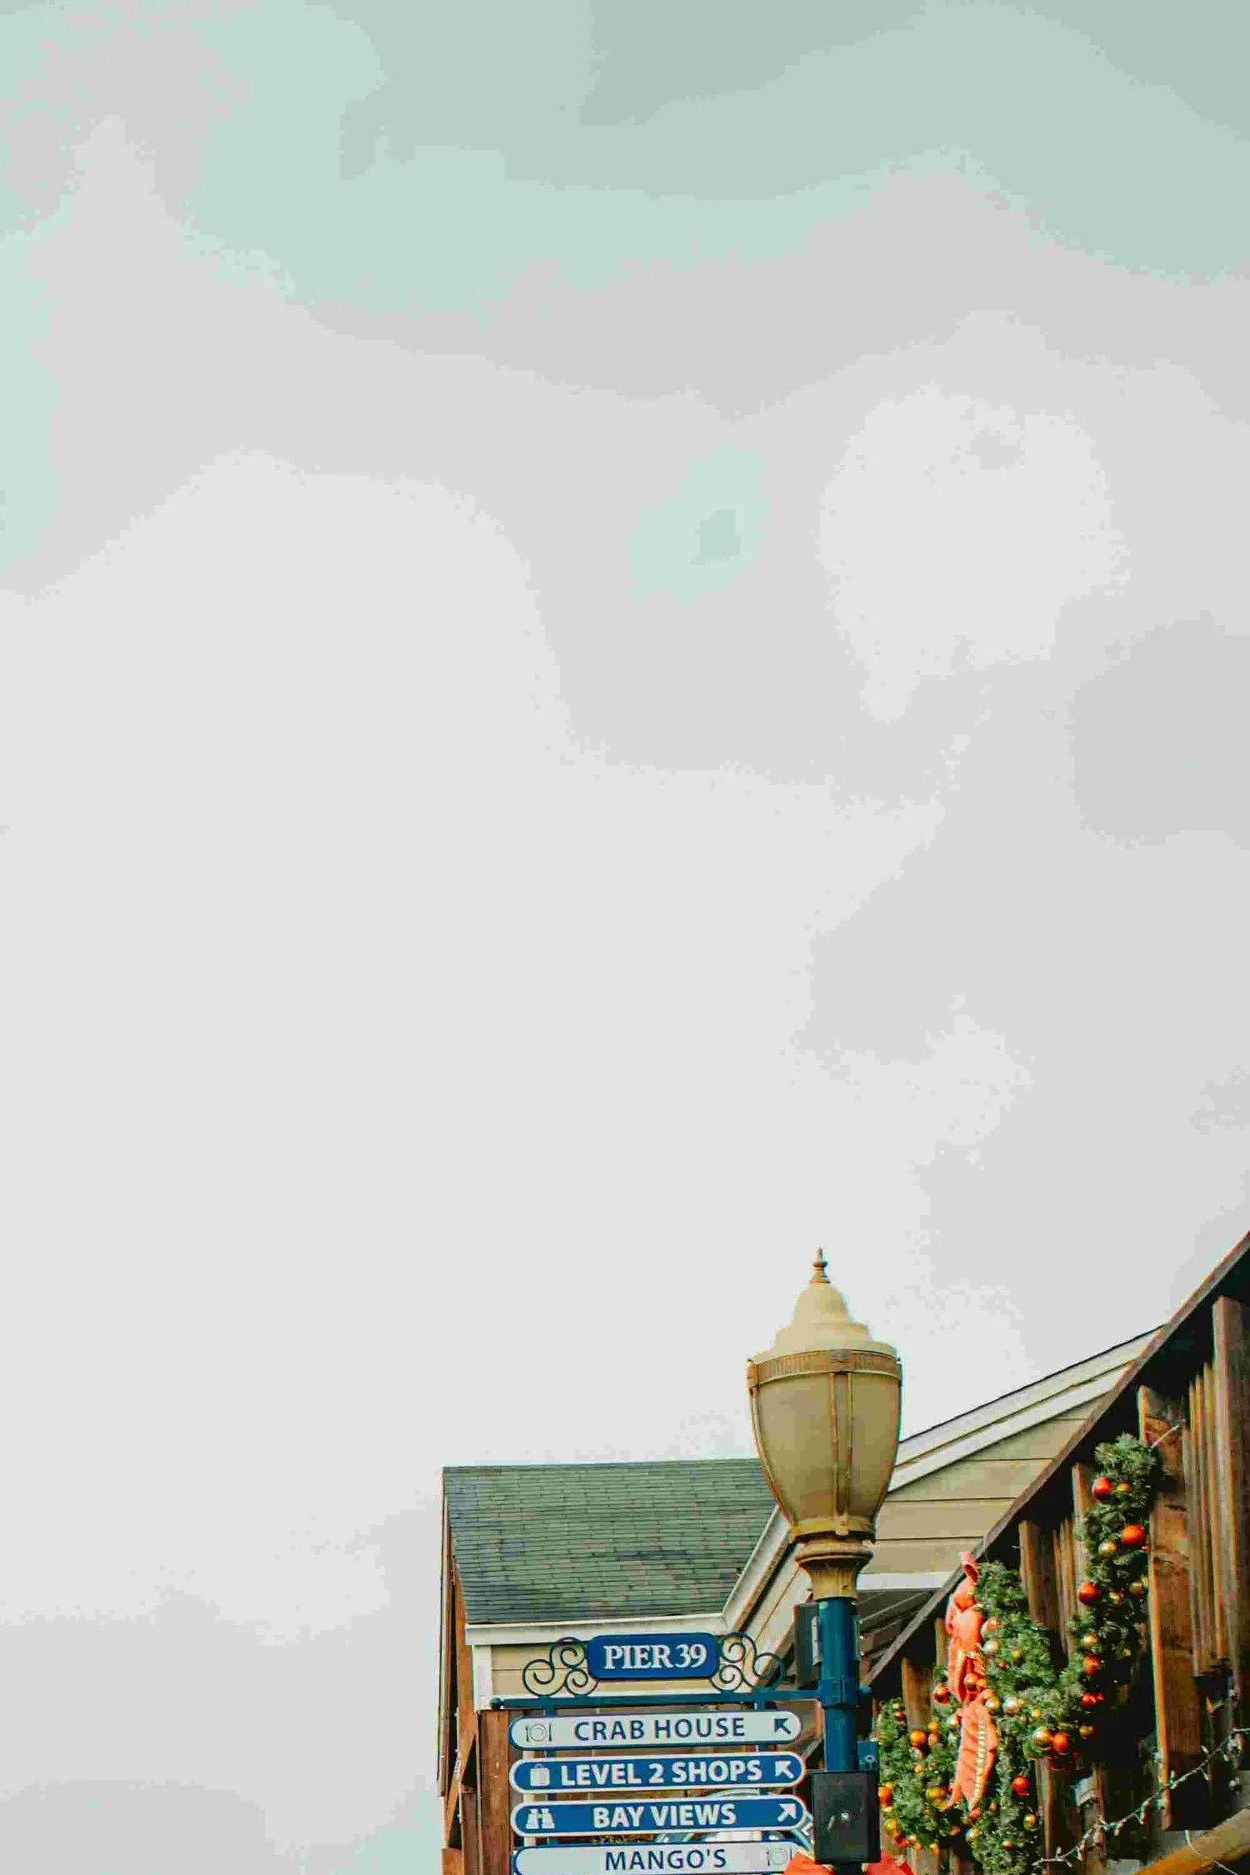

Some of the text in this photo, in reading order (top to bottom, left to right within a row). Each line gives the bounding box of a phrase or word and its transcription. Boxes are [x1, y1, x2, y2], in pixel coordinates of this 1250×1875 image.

[604, 1643, 707, 1670] PIER 39
[574, 1717, 746, 1742] CRAB HOUSE
[561, 1759, 763, 1786] LEVEL 2 SHOPS
[593, 1803, 737, 1829] BAY VIEWS
[605, 1848, 727, 1872] MANGO'S
